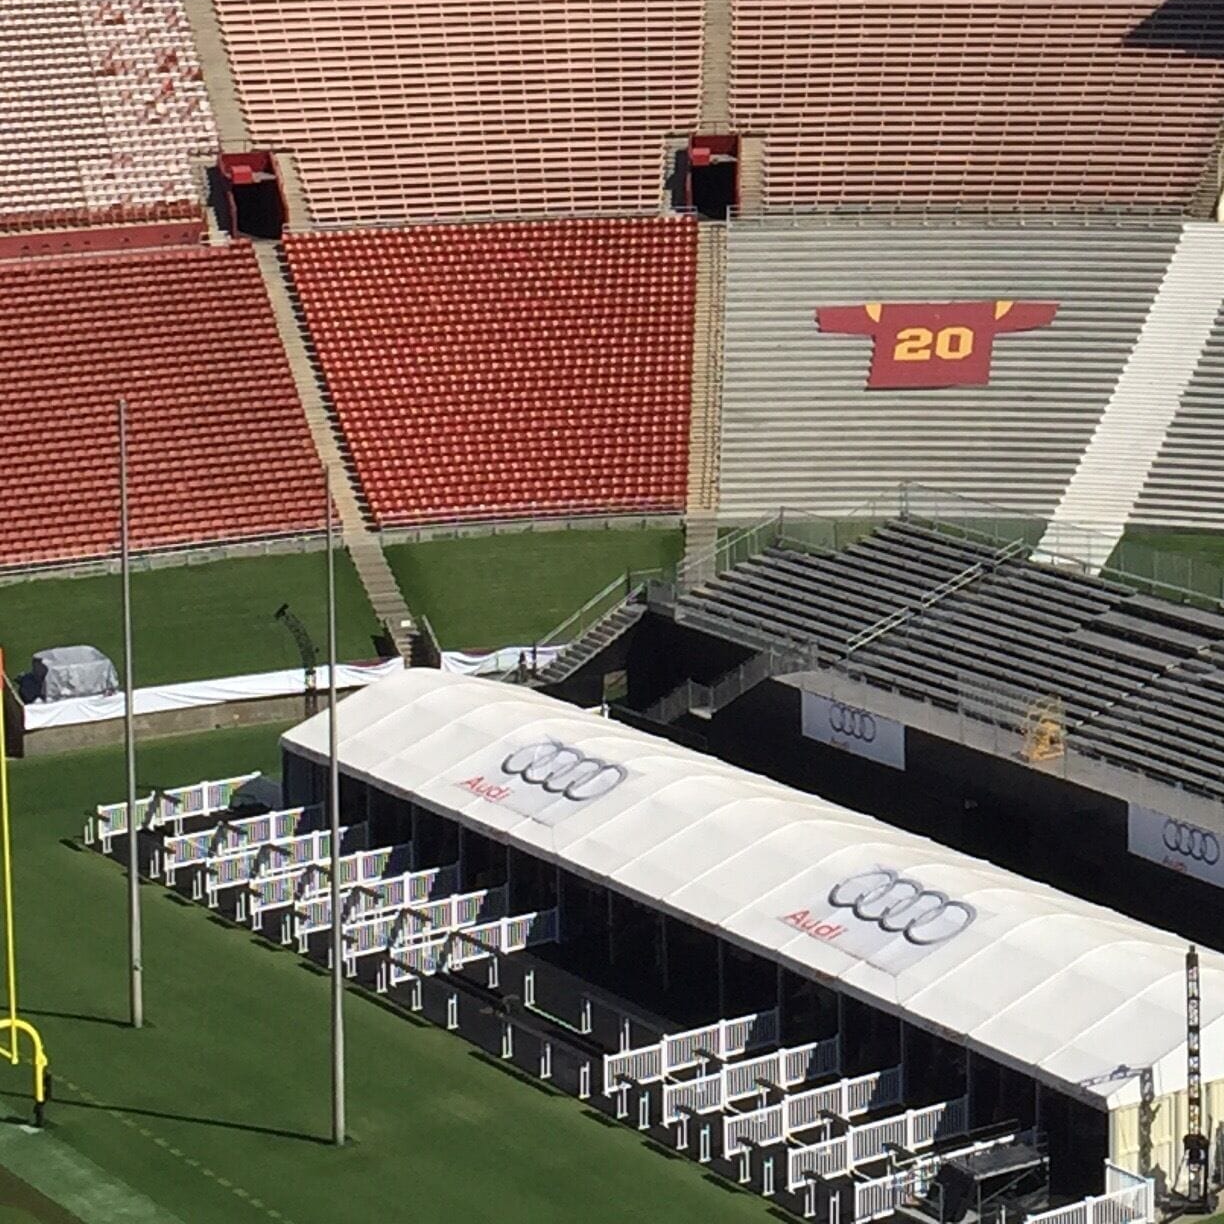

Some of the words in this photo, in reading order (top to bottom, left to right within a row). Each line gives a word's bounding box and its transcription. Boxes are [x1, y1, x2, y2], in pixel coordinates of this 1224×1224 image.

[894, 326, 975, 361] 20
[460, 774, 511, 803] Audi
[784, 908, 845, 942] Audi
